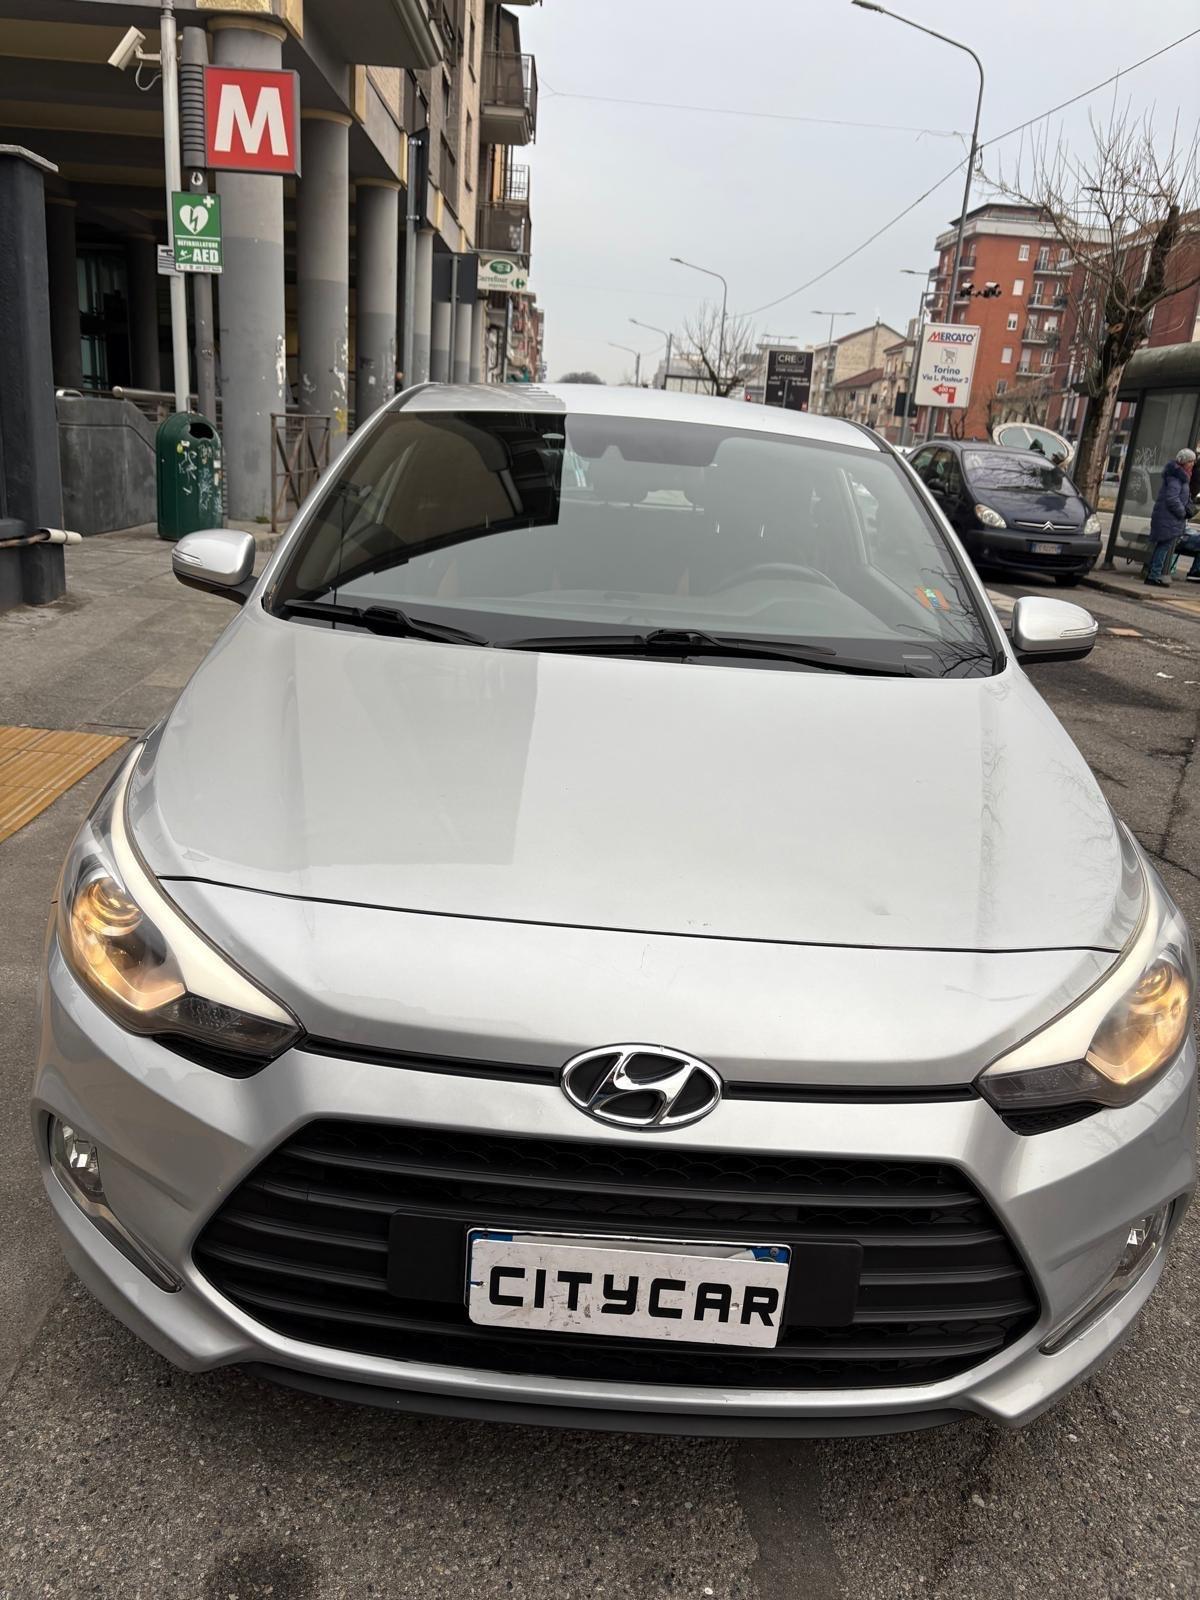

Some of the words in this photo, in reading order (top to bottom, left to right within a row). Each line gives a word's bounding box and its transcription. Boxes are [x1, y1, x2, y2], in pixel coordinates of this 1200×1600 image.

[214, 83, 289, 157] M
[192, 248, 219, 263] AED
[933, 365, 960, 375] Torino
[489, 1265, 780, 1327] CITYCAR
